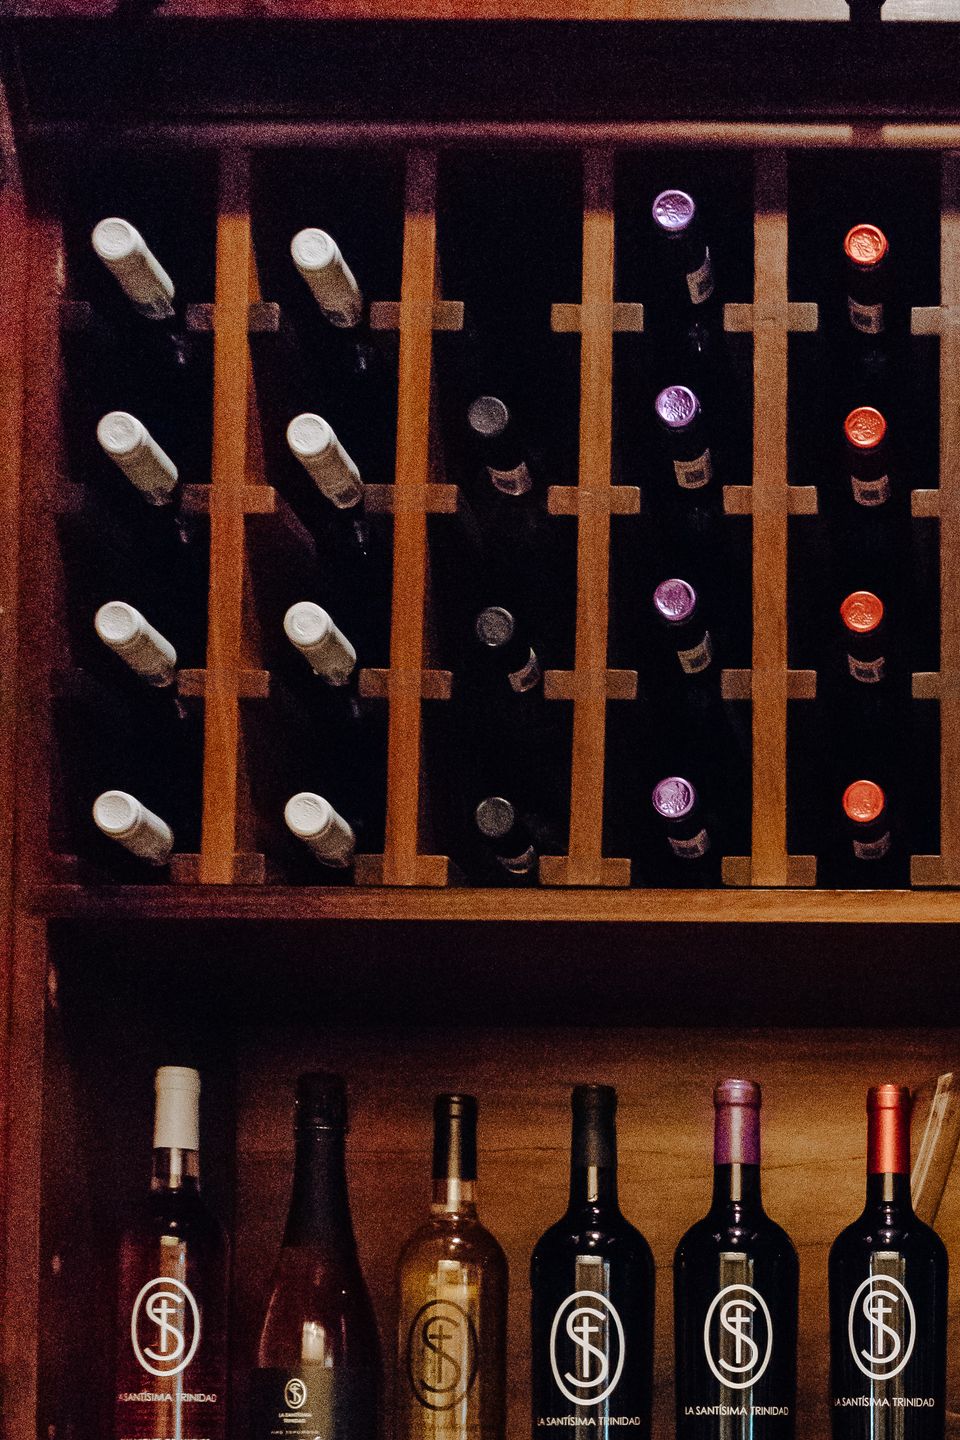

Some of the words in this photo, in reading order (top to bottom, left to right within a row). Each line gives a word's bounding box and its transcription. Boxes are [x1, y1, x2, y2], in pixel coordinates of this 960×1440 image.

[892, 1398, 935, 1407] TRINIDAD
[684, 1406, 695, 1415] LA
[696, 1403, 747, 1416] SANTÍSIMA
[750, 1406, 789, 1416] TRINIDAD
[546, 1415, 596, 1426] SANTÍSIMA
[598, 1417, 641, 1426] TRINIDAD
